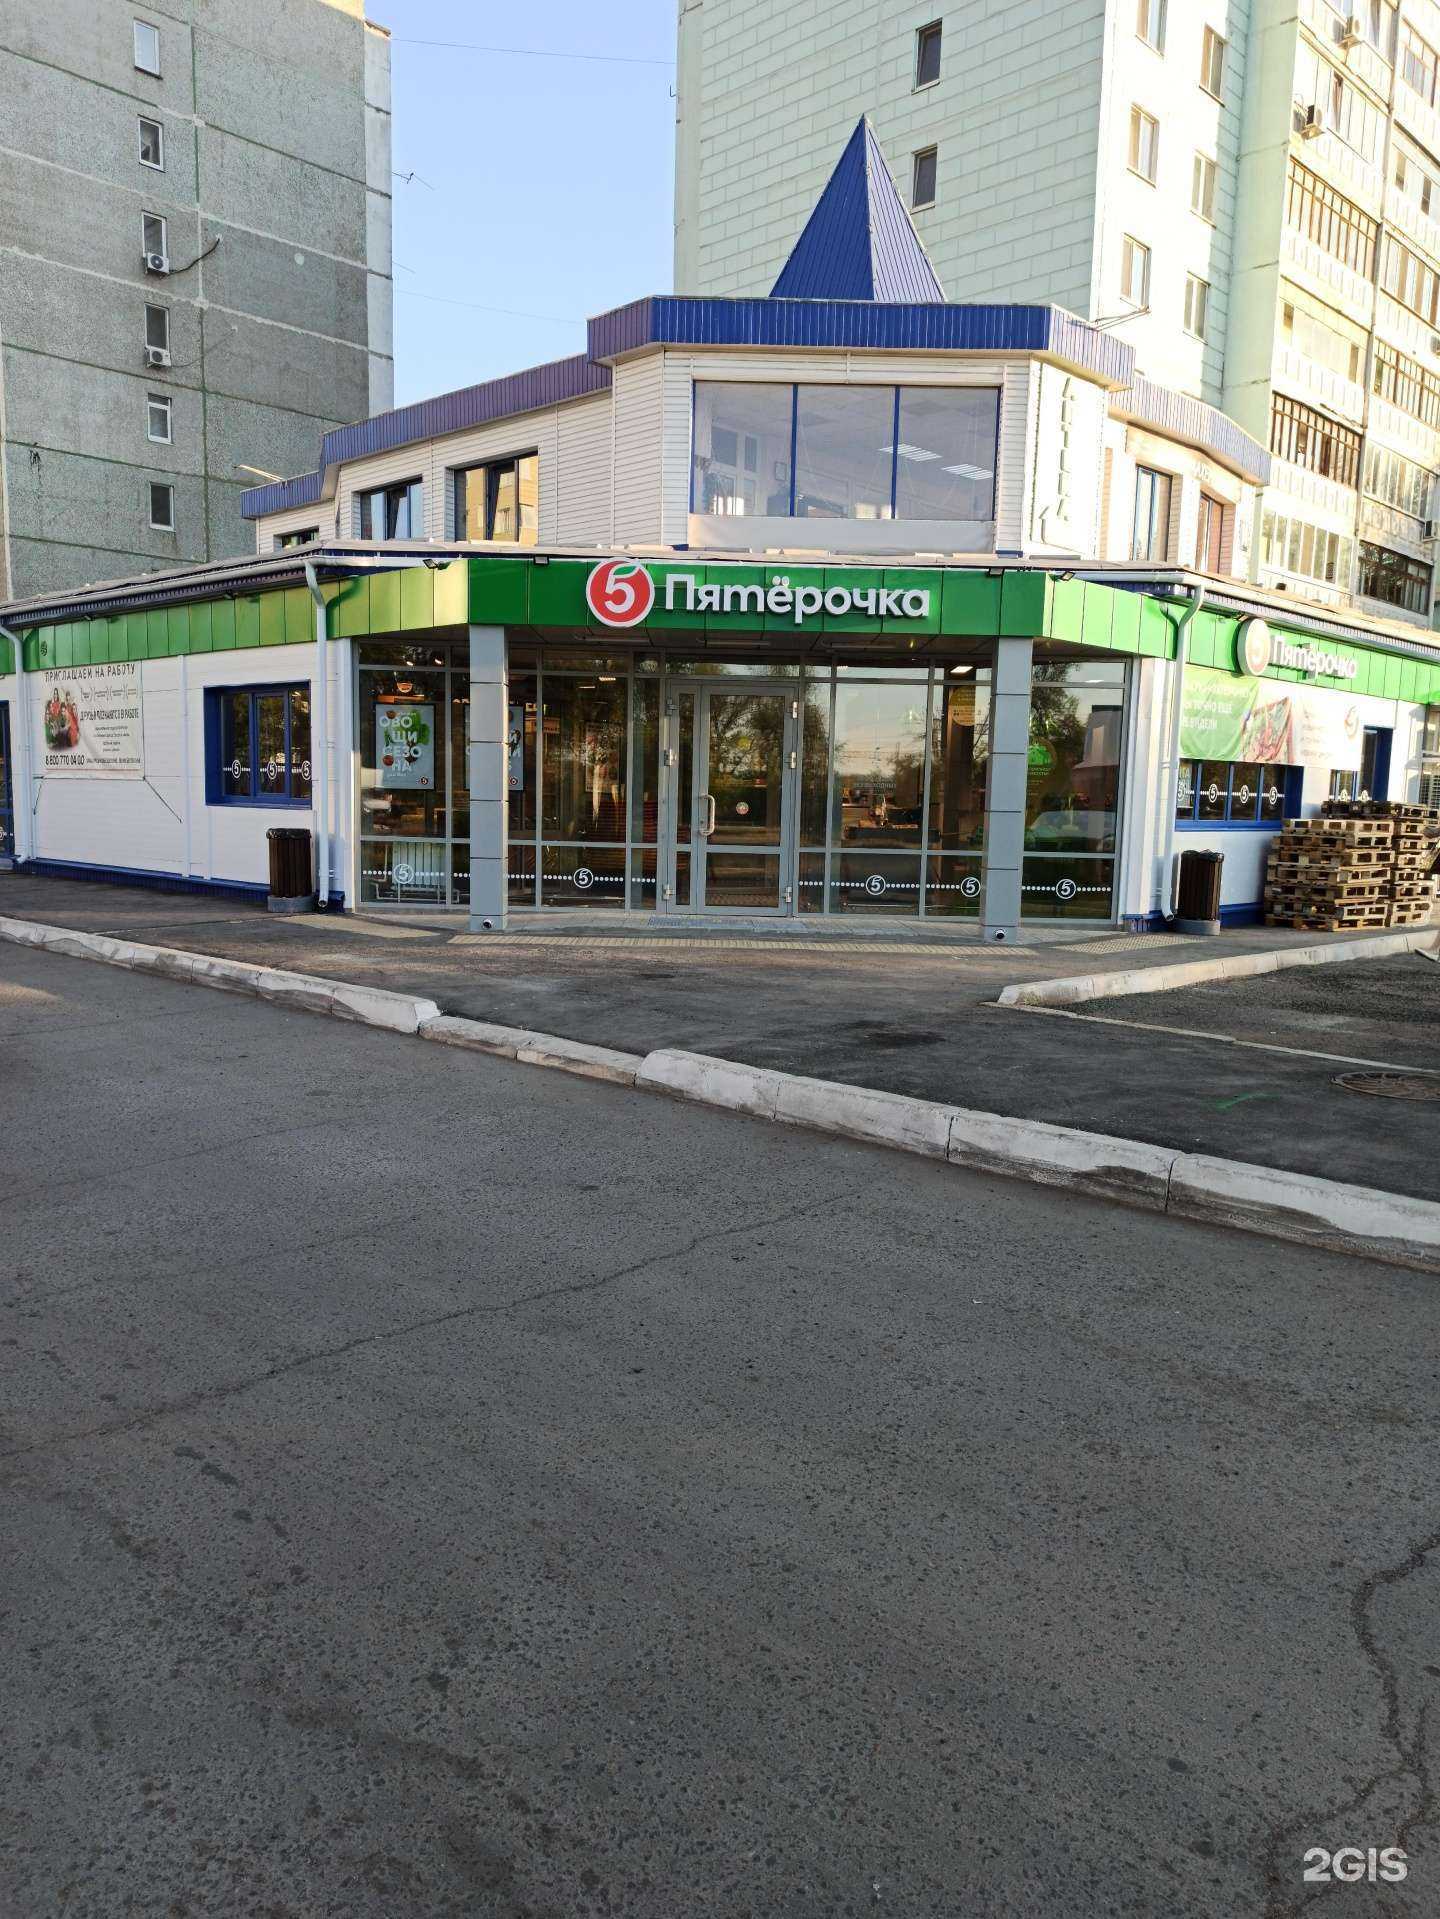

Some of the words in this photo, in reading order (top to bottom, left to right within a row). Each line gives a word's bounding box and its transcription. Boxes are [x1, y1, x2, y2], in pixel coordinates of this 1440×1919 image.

[665, 574, 930, 624] Пятёрочка
[1273, 635, 1357, 679] Пятёрочка
[95, 667, 104, 677] НА
[107, 664, 135, 676] РАБОТУ
[379, 716, 412, 728] ОВО
[60, 755, 69, 765] 770
[398, 866, 408, 881] 5
[579, 871, 590, 886] 5
[870, 878, 881, 892] 5
[966, 879, 976, 894] 5
[1061, 881, 1072, 896] 5
